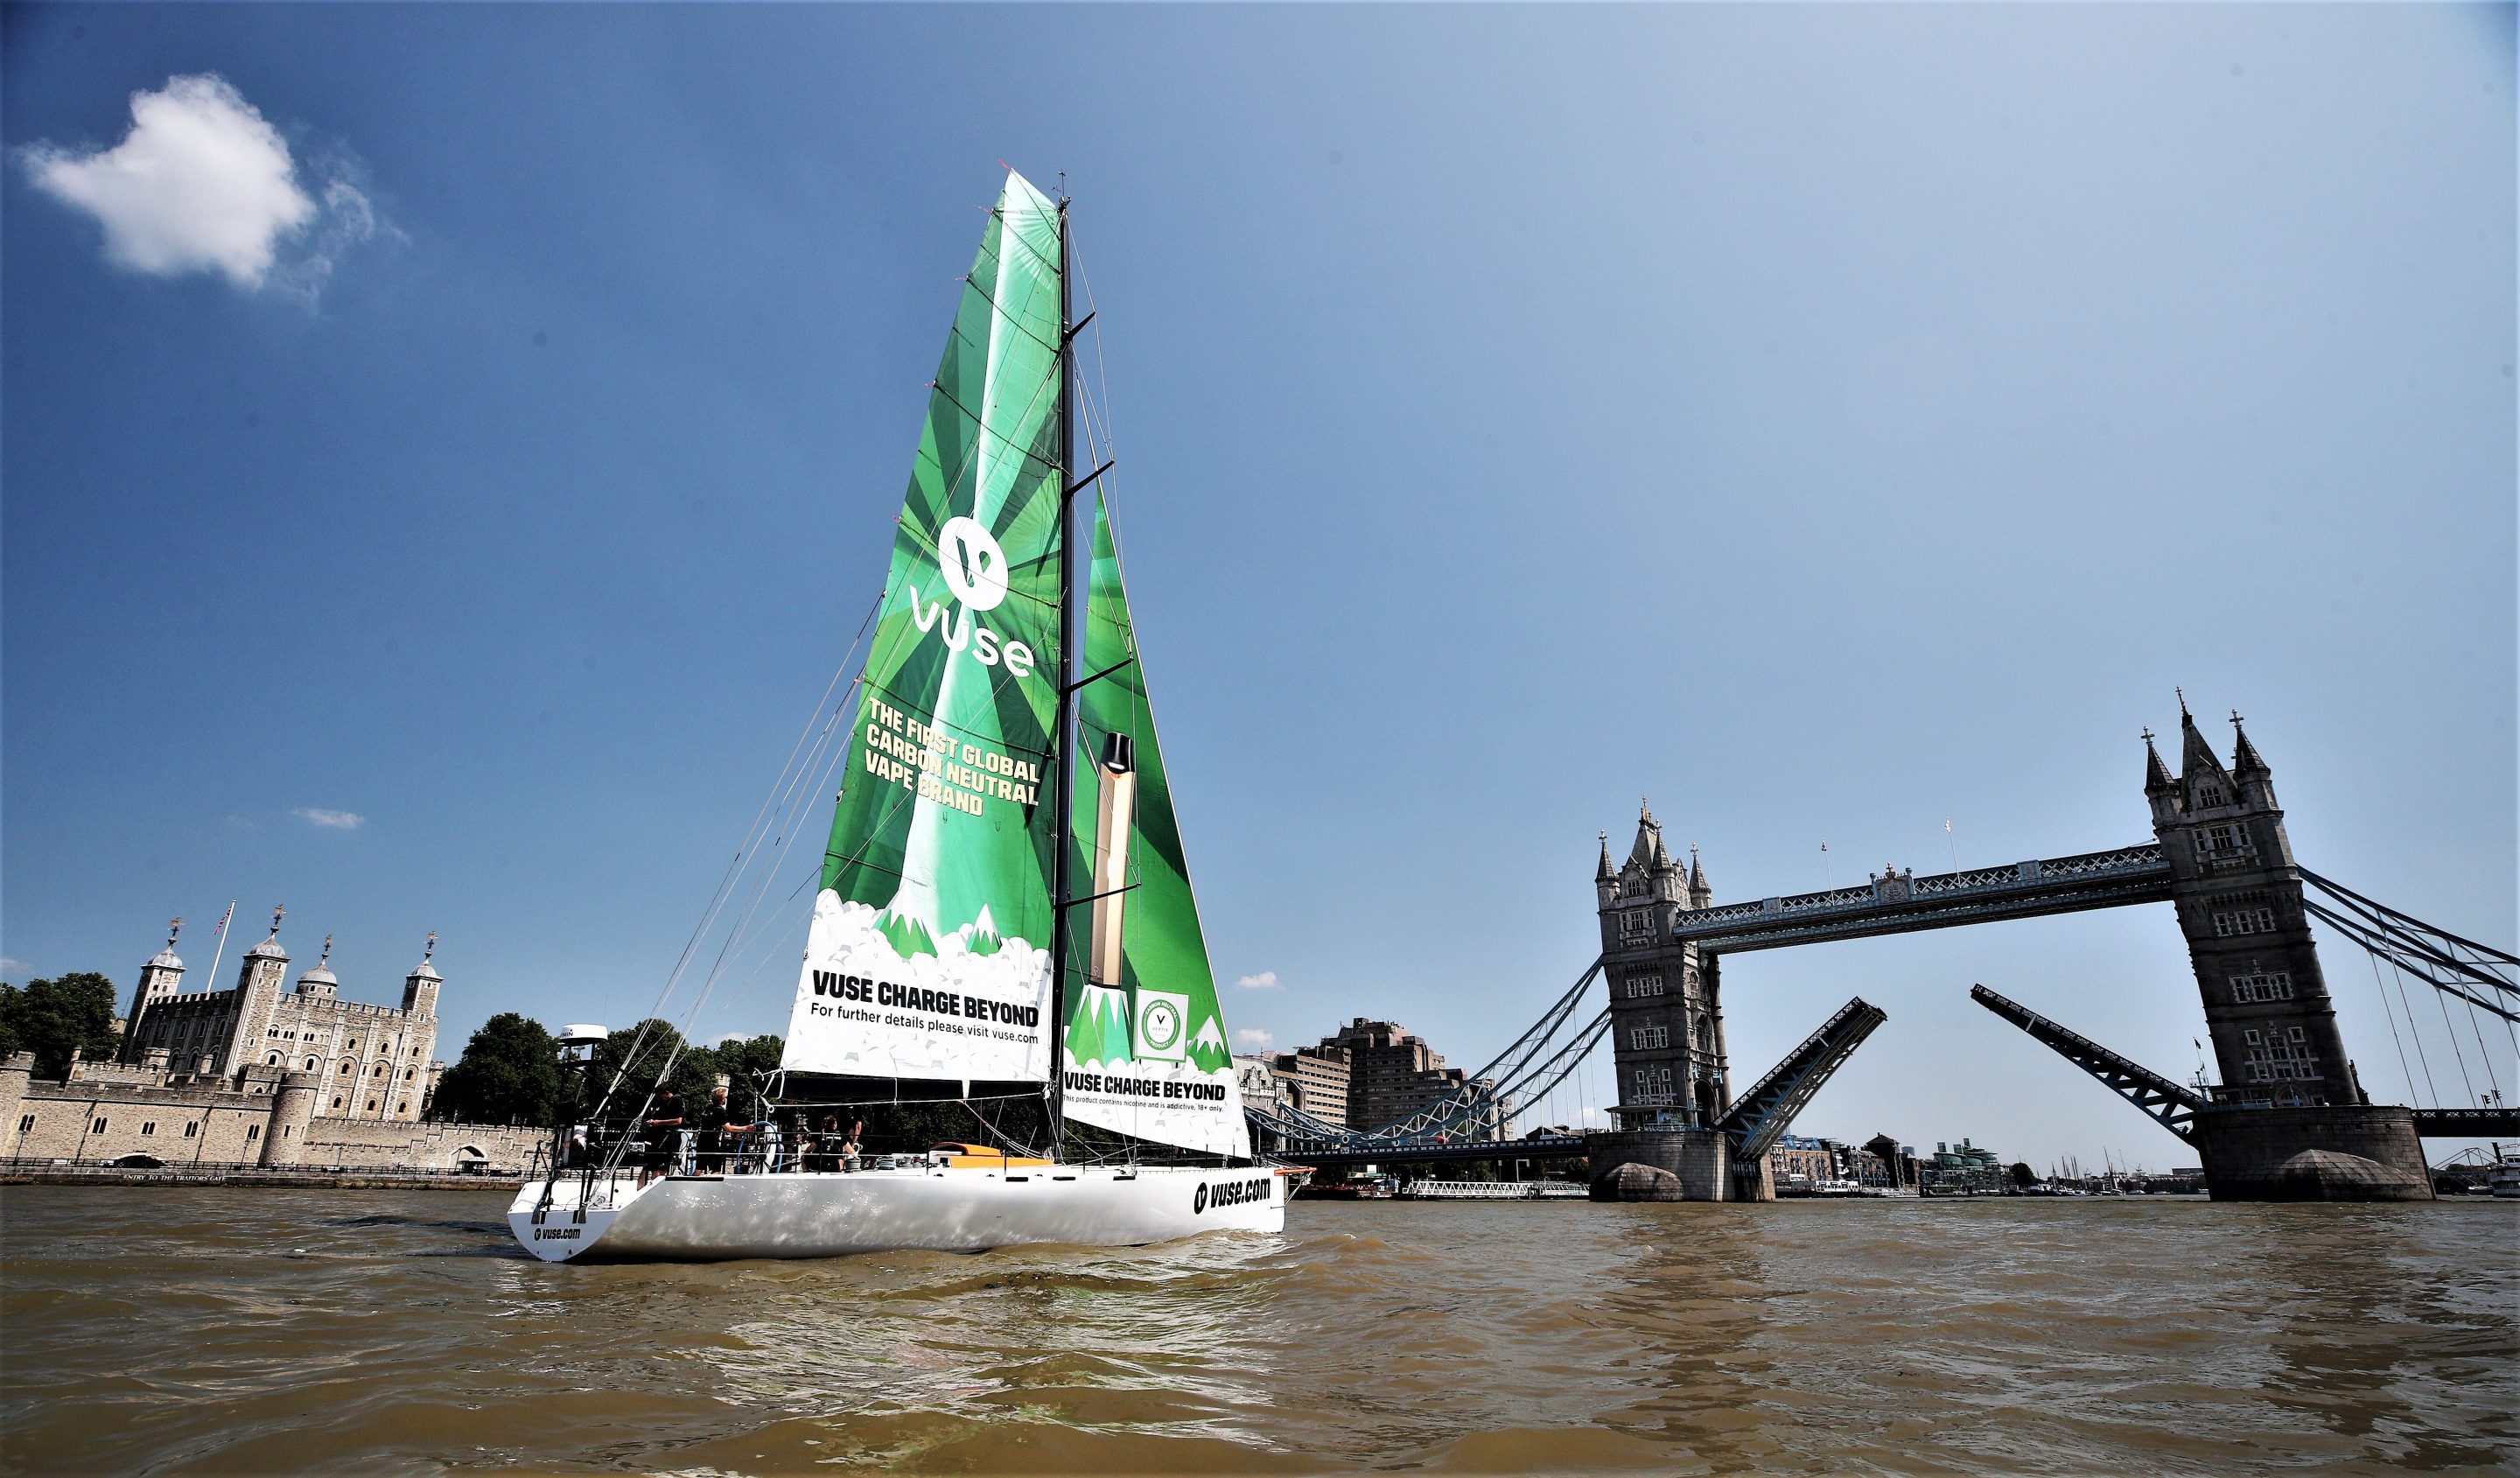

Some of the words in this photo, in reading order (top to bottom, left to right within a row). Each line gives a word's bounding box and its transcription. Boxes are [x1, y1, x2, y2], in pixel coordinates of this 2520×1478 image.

[909, 584, 1035, 677] vuse
[870, 697, 904, 733] THE
[906, 717, 959, 759] FIRST
[962, 744, 1040, 783] GLOBAL
[865, 748, 914, 791] VAPE
[918, 774, 983, 816] BRAND
[867, 724, 942, 778] CARBON
[946, 760, 1039, 806] NEUTRAL
[811, 1002, 833, 1017] For
[837, 1005, 880, 1023] further
[885, 1013, 924, 1029] details
[928, 1019, 963, 1033] please
[967, 1025, 989, 1037] visit
[991, 1030, 1039, 1044] vuse.com
[813, 970, 872, 1003] VUSE
[878, 982, 960, 1016] CHARGE
[964, 996, 1039, 1027] BEYOND
[1161, 1002, 1178, 1018] NEUTRAL
[1065, 1072, 1102, 1092] VUSE
[1104, 1076, 1161, 1096] CHARGE
[1164, 1082, 1226, 1101] BEYOND
[1211, 1178, 1270, 1208] vuse.com
[542, 1229, 581, 1240] vuse.com
